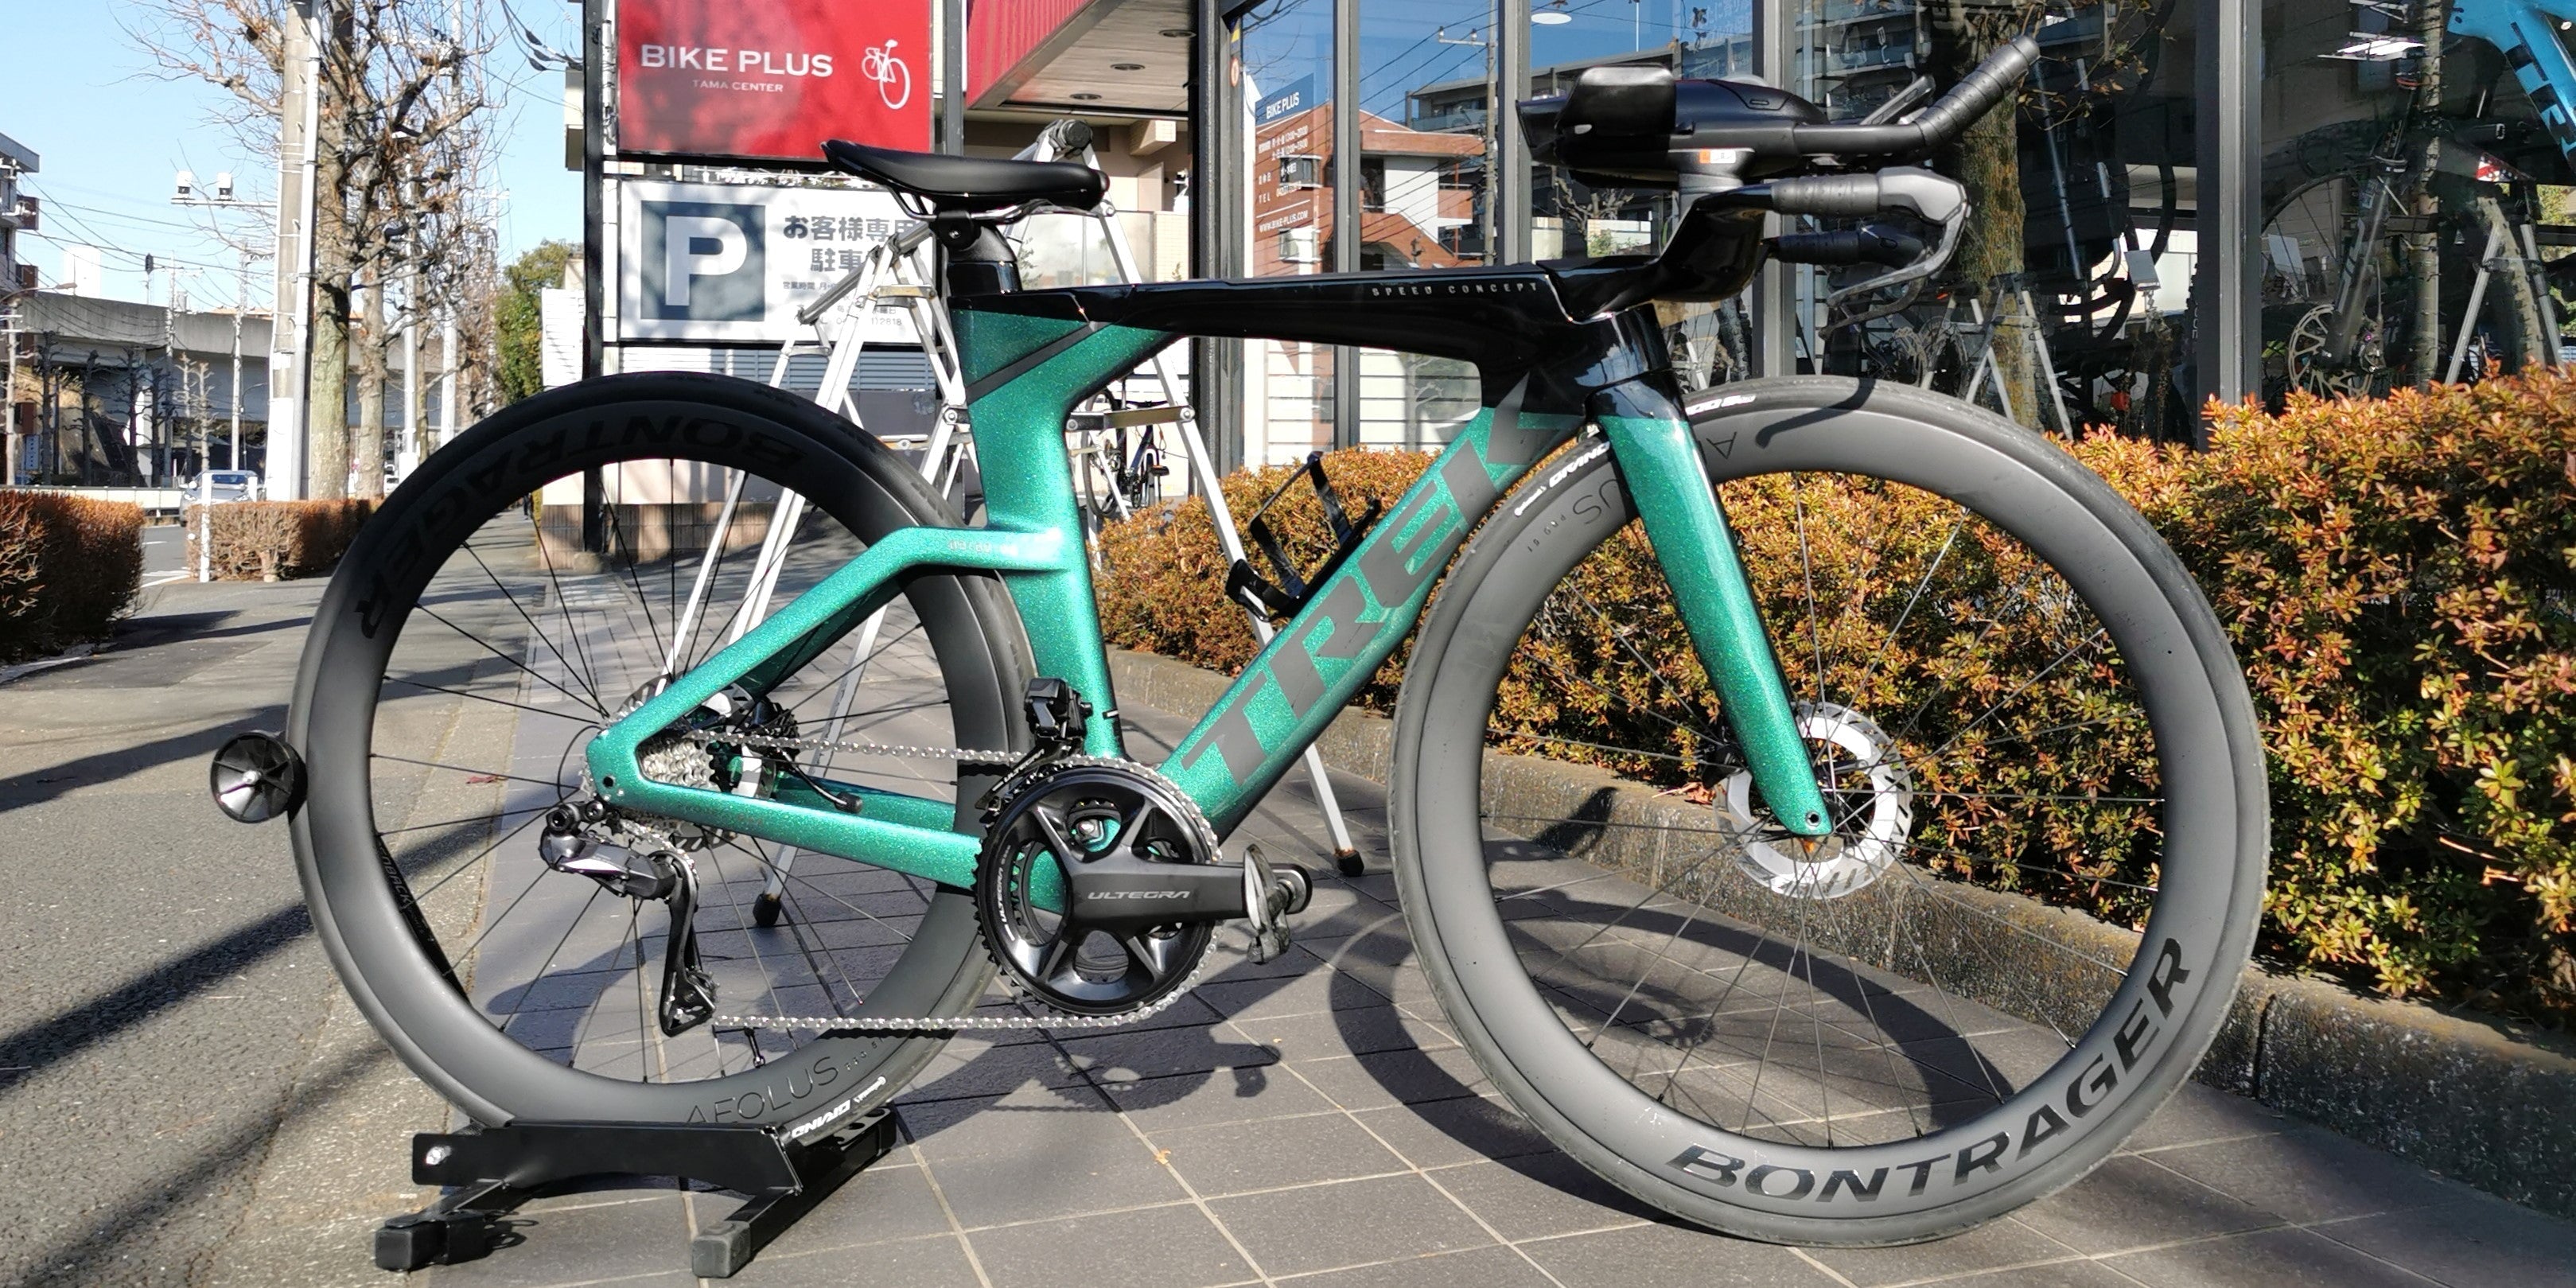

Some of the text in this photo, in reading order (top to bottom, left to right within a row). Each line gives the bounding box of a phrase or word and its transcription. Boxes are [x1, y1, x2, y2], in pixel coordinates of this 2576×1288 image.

[641, 44, 834, 78] BIKE PLUS
[692, 79, 784, 93] TAMA CENTER
[1266, 91, 1300, 119] BIKE PLUS
[665, 216, 748, 306] P
[810, 248, 868, 274] 駐車
[1372, 282, 1539, 297] SPEED CONCEPT
[355, 414, 807, 640] BONTRAGER
[1182, 372, 1579, 787] TREK
[1088, 890, 1190, 901] ULTEGRA
[1665, 937, 2191, 1202] BONTRAGER
[687, 1056, 839, 1123] AEOLUS
